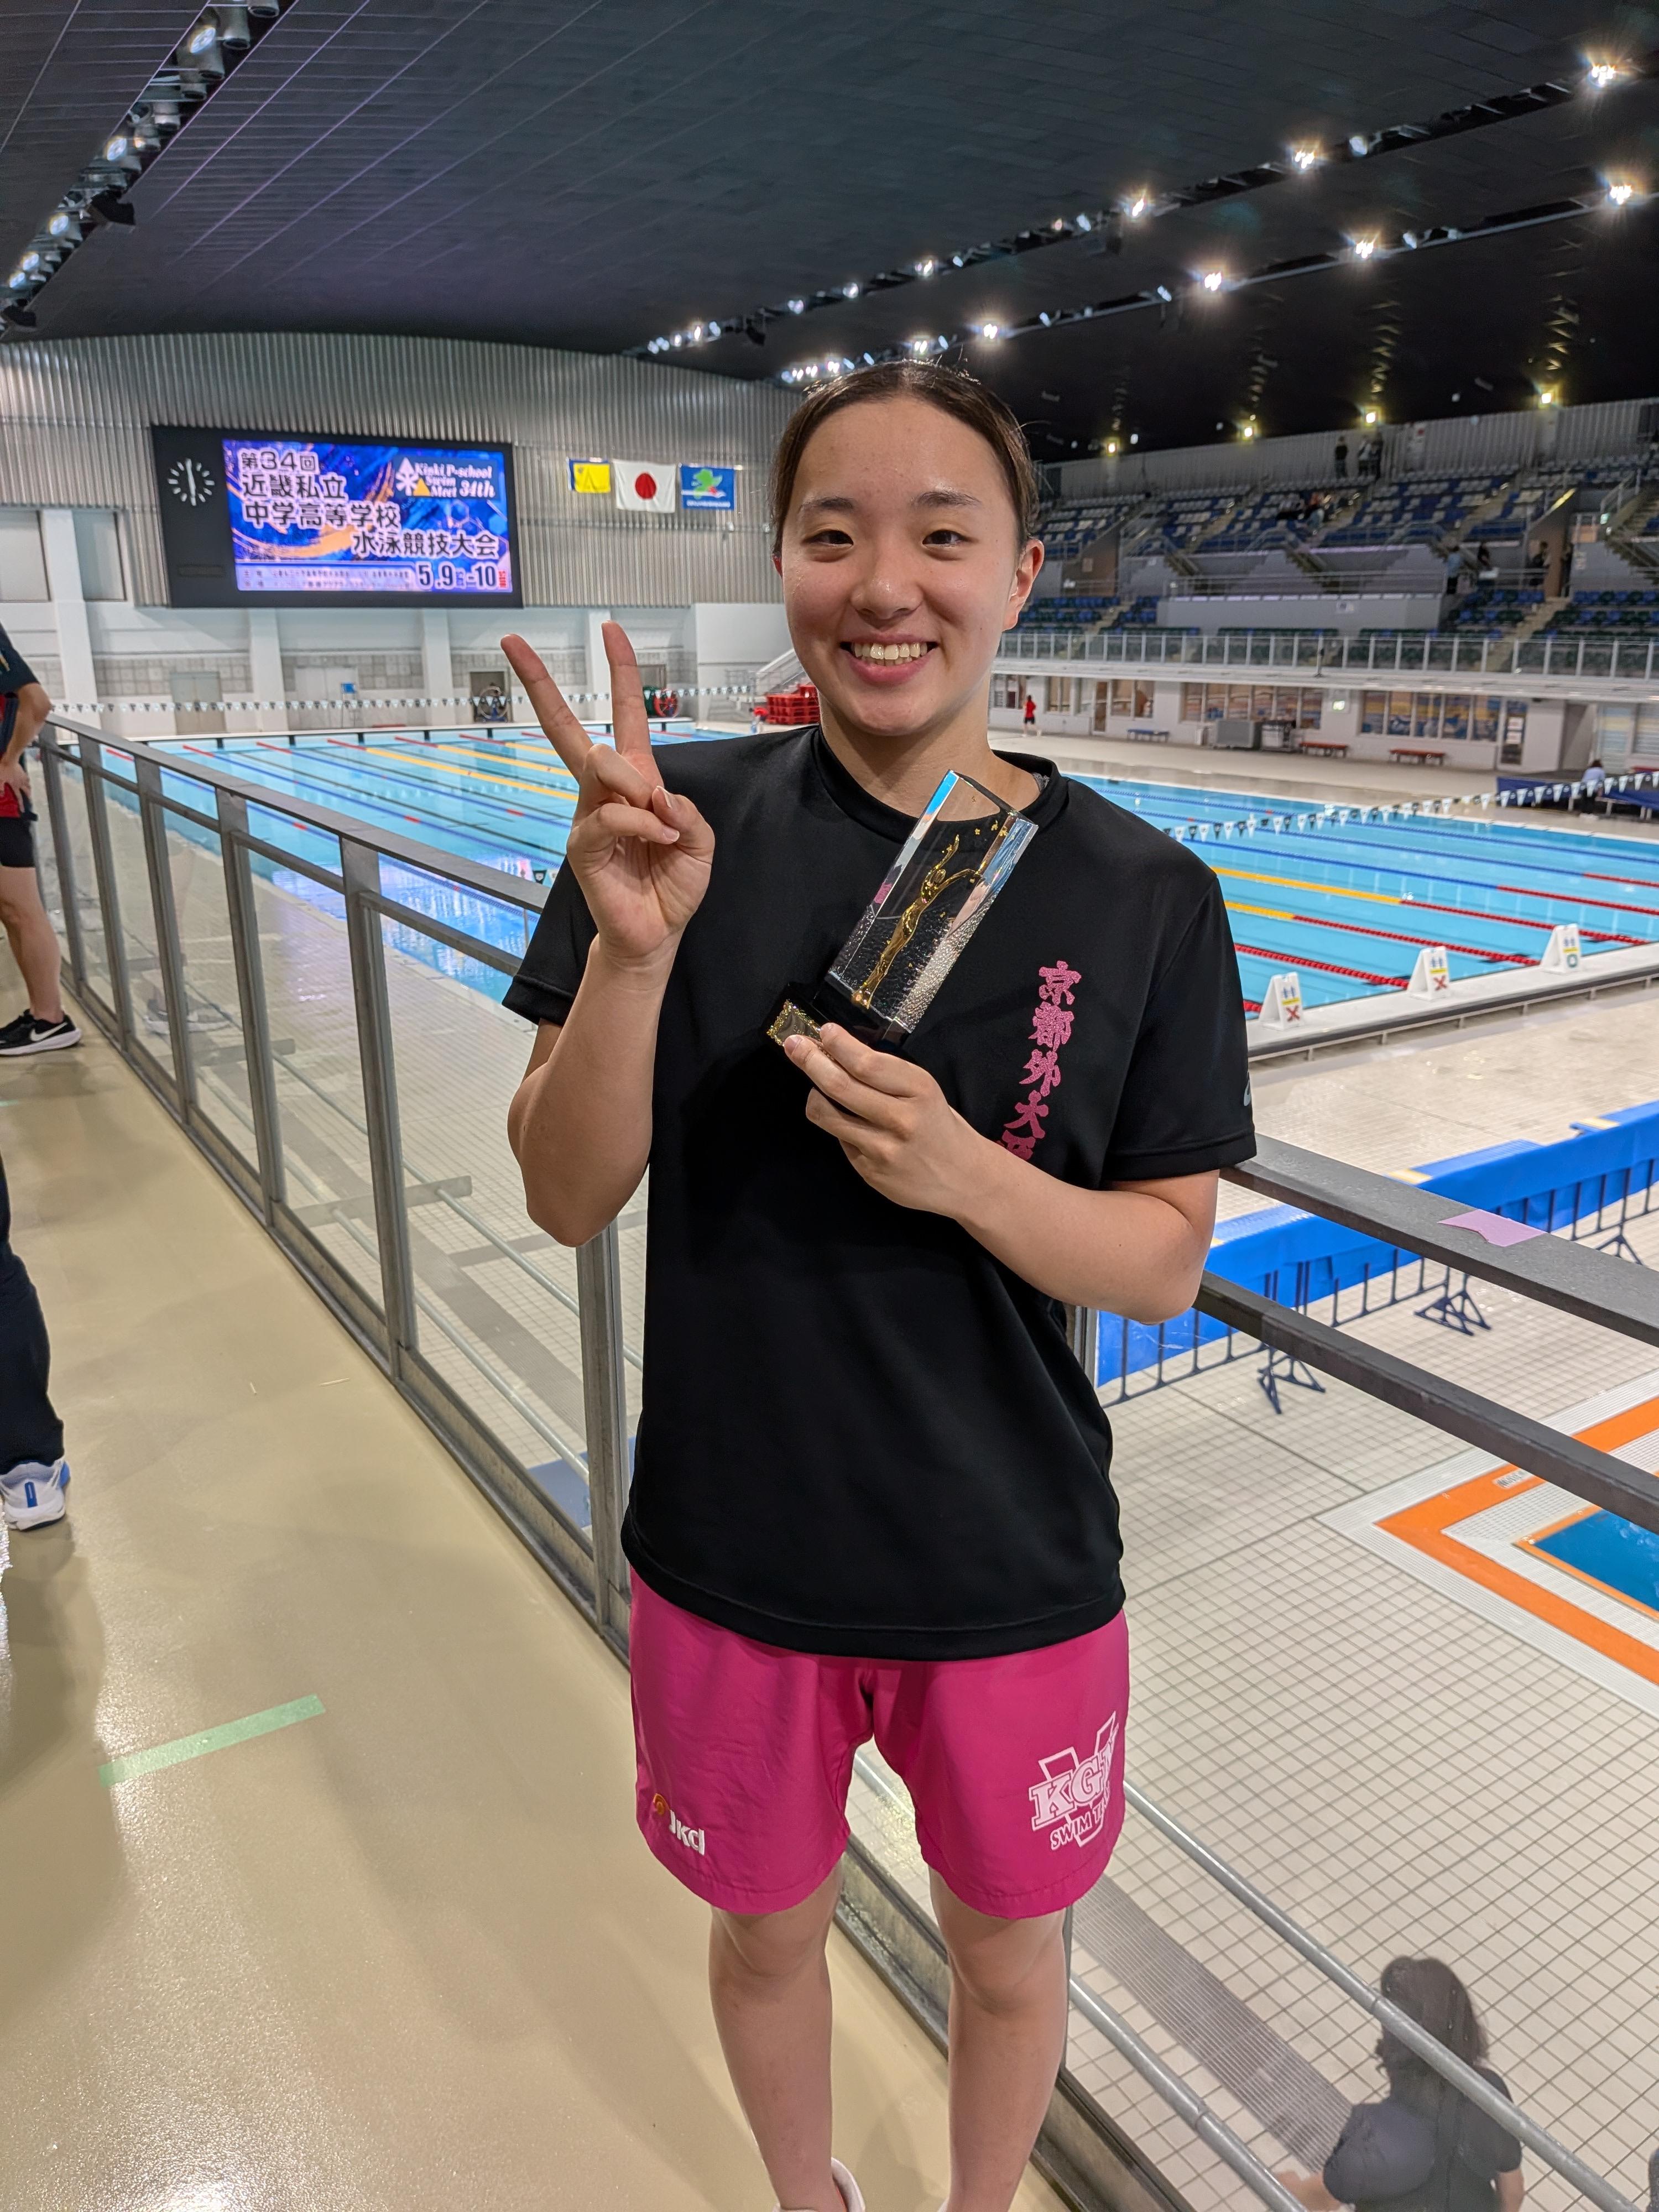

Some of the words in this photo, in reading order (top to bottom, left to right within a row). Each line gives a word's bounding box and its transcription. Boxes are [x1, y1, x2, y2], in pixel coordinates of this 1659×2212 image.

[241, 451, 315, 471] 第34回
[242, 474, 346, 498] 近畿私立
[459, 479, 495, 498] 34th
[245, 500, 398, 528] 中学高等学校
[353, 531, 495, 557] 水泳競技大会
[1050, 1809, 1093, 1850] SWIM
